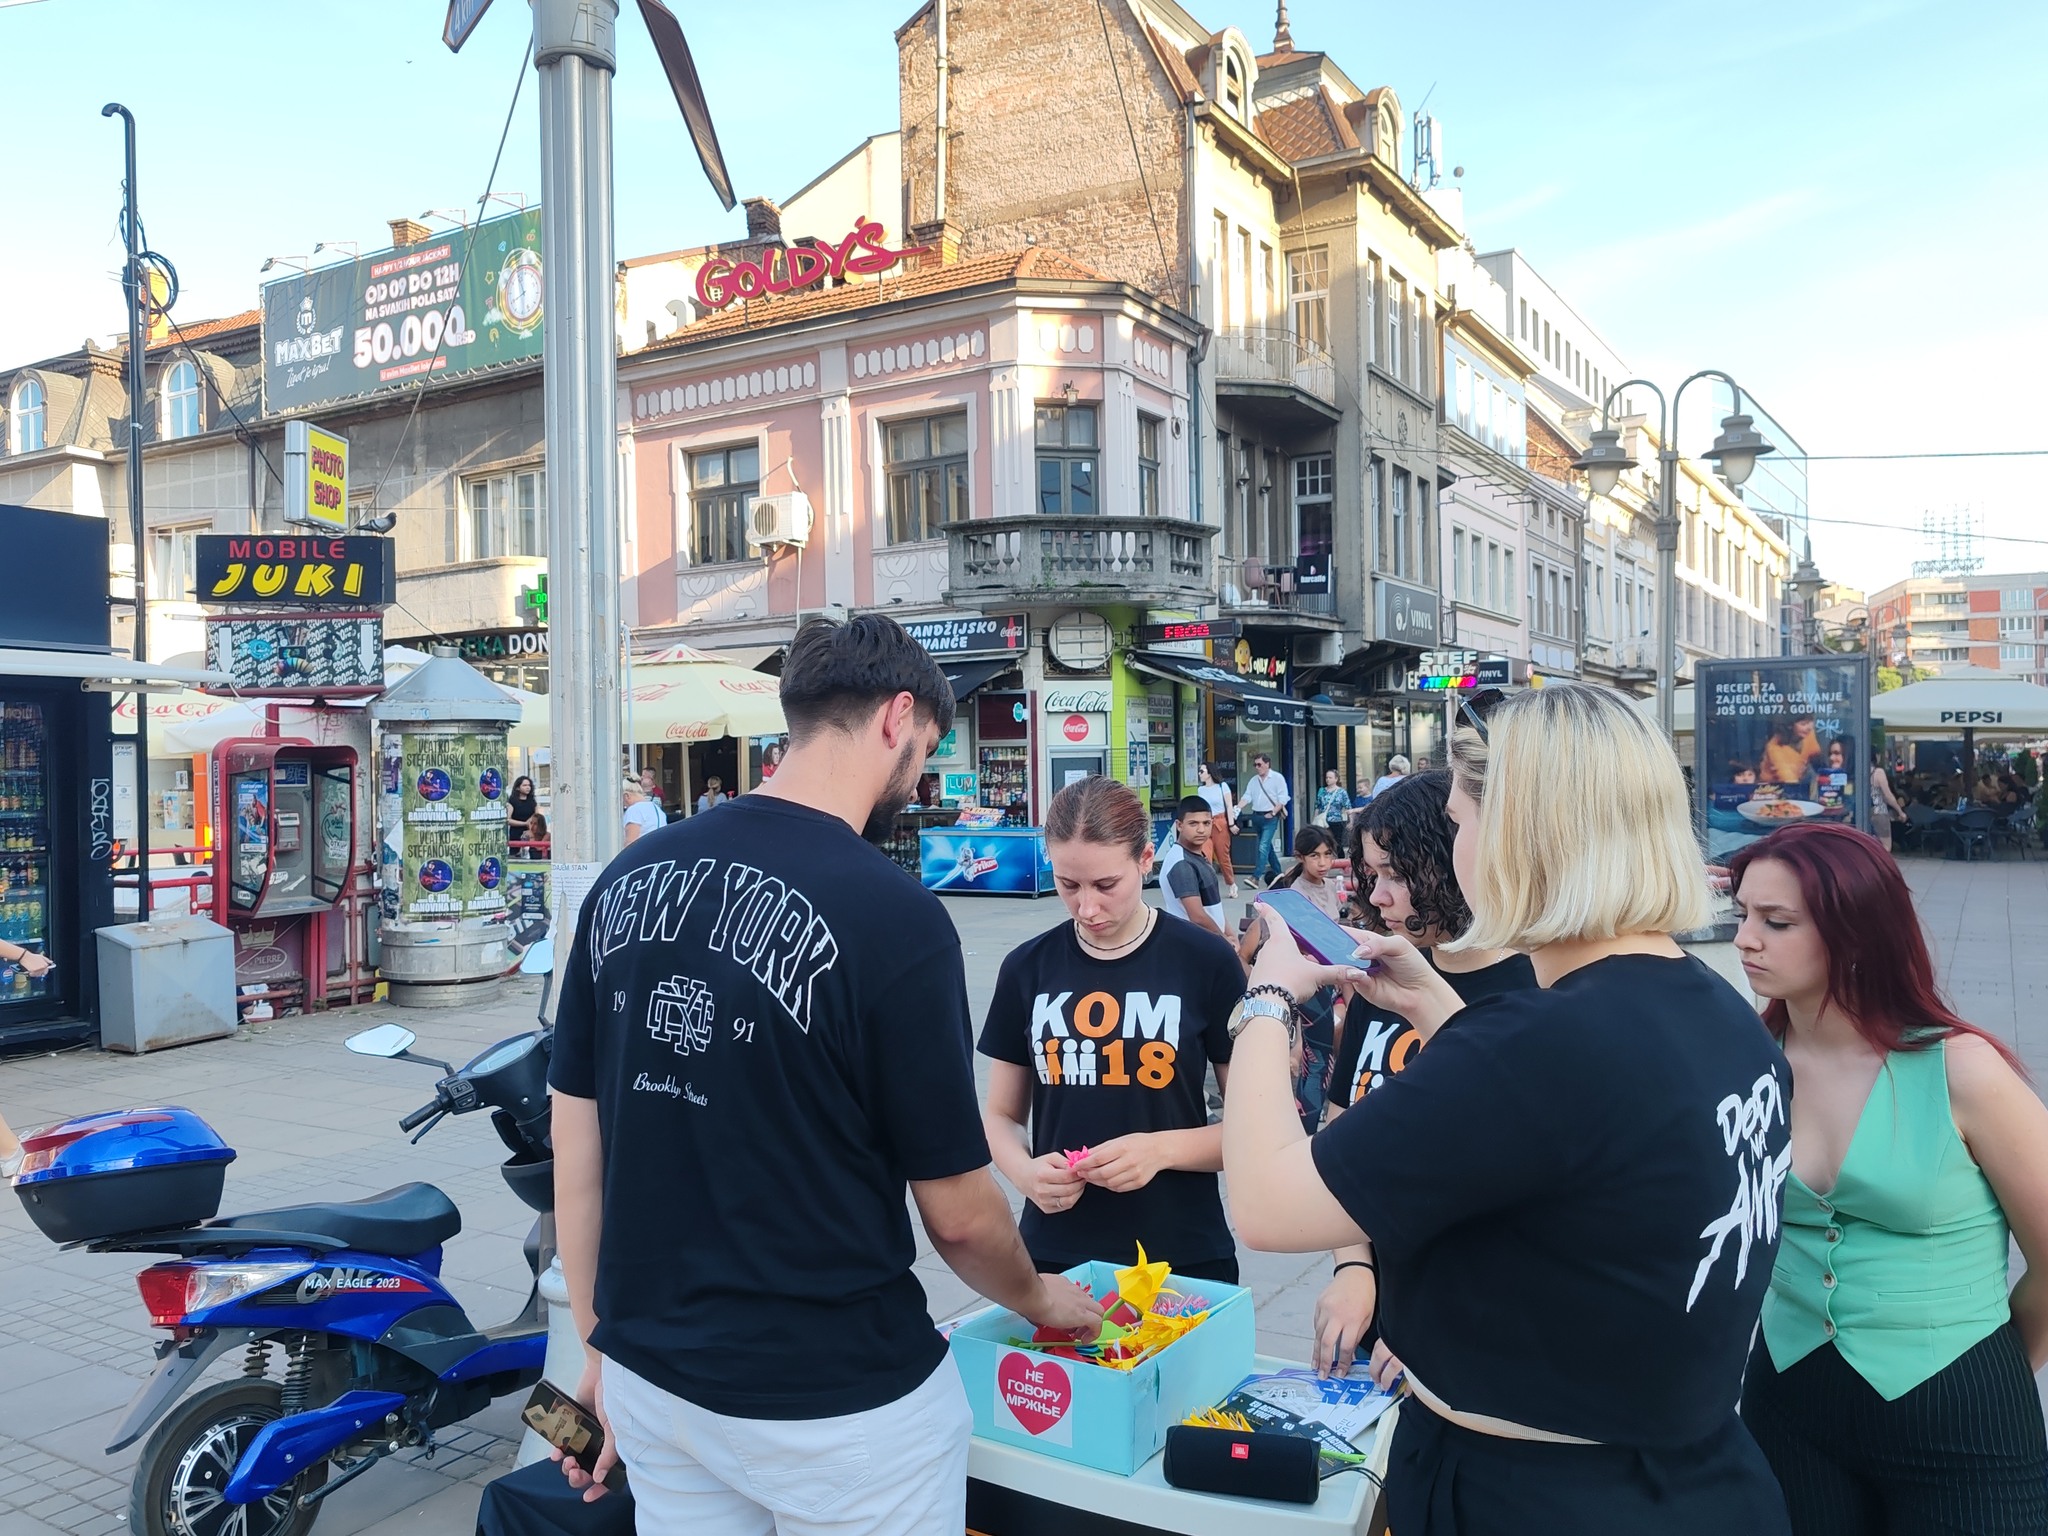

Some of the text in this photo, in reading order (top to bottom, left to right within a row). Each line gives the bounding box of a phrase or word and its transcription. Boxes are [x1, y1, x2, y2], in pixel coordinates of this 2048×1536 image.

[374, 264, 394, 276] HAPPY
[421, 247, 449, 262] JACKPOT
[365, 262, 459, 305] OD 09 DO 12H
[365, 285, 460, 321] NA SVAKIH POLA SATA
[353, 304, 477, 368] 50.000 RSD
[311, 445, 344, 480] PHOTO
[313, 480, 342, 511] SHOP
[229, 539, 346, 560] MOBILE
[211, 562, 364, 598] JUKI
[1410, 608, 1433, 631] VINYL
[1164, 623, 1210, 639] FROG
[416, 635, 506, 657] APTEKA
[1419, 650, 1478, 665] STEF
[1418, 664, 1464, 677] ANO
[1715, 690, 1843, 705] ZAJEDNIČKO UŽIVANJE
[1716, 682, 1776, 693] RECEPT ZA
[1715, 703, 1837, 716] JOŠ OD 1877. GODINE.
[1940, 710, 2003, 724] PEPSI
[590, 858, 716, 983] NEW
[708, 862, 839, 1035] YORK
[254, 953, 282, 965] PIERRE
[612, 990, 755, 1043] 19 91
[1032, 991, 1181, 1052] KOM
[1102, 1041, 1177, 1090] 18
[304, 1277, 401, 1289] MAX EAGLE 2023
[1025, 1368, 1045, 1384] НЕ
[1007, 1378, 1062, 1403] ГОВОРУ
[1006, 1392, 1061, 1419] МРЖЊЕ
[1249, 1400, 1290, 1420] EU ACTIONS
[1251, 1409, 1271, 1422] YOUT
[1282, 1421, 1295, 1431] EU
[1317, 1428, 1331, 1439] EU
